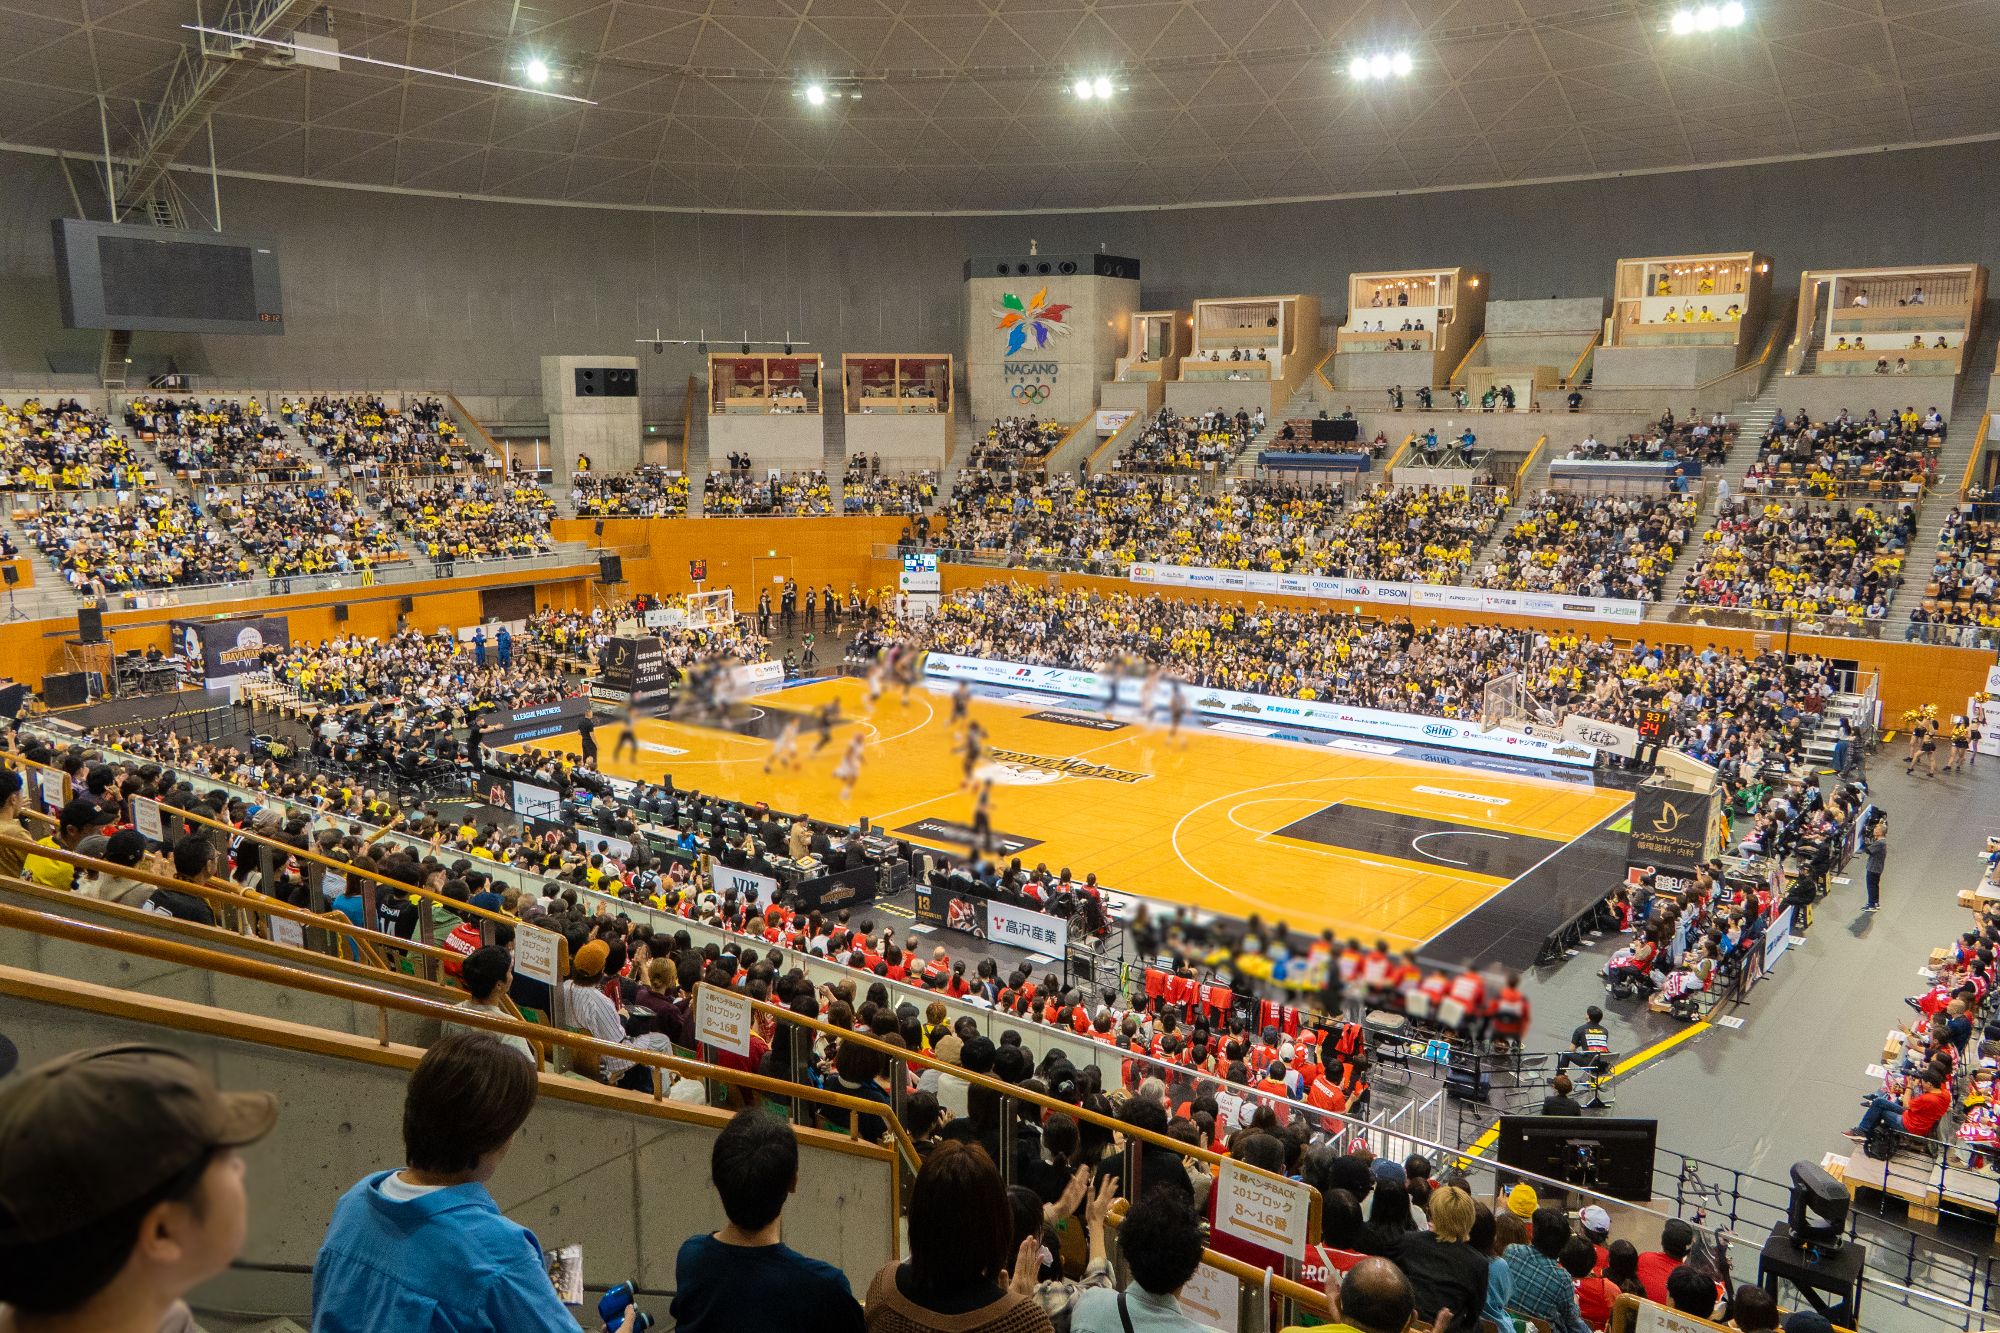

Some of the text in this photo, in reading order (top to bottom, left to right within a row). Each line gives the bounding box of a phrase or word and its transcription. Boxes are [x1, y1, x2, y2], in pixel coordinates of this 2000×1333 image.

[1004, 364, 1058, 376] NAGANO
[1312, 582, 1339, 590] ORION
[1378, 588, 1408, 598] EPSON
[1646, 712, 1666, 722] 9:31
[1640, 722, 1660, 736] 24
[1632, 831, 1702, 848] みうらハートクリニック
[918, 895, 931, 910] 13
[380, 904, 401, 917] EPSON
[1006, 919, 1057, 945] 高沢産業
[705, 1004, 742, 1020] 201ブロック
[1233, 1172, 1296, 1200] 2階ベンチBACK
[1232, 1186, 1292, 1212] 201ブロック
